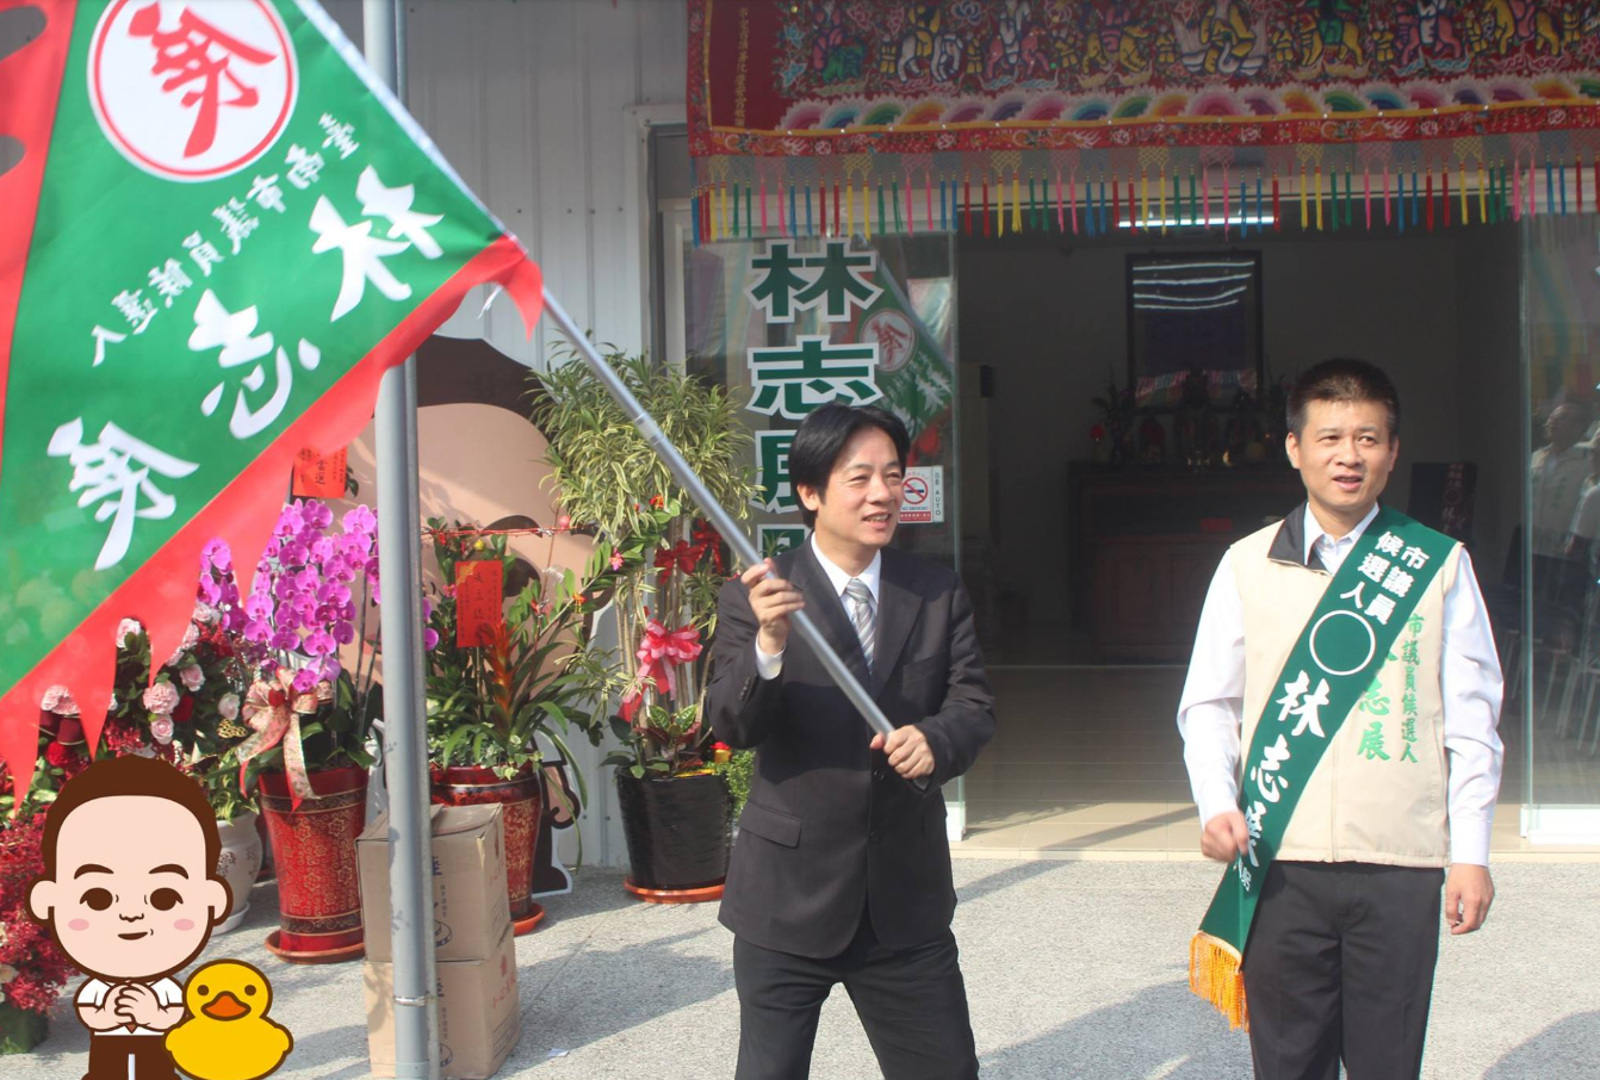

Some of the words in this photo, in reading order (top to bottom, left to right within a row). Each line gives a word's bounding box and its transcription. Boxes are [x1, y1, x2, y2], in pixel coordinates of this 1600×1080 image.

[1340, 531, 1404, 609] 候選人
[1364, 546, 1430, 625] 市議員
[1399, 613, 1425, 764] 市議員候選人
